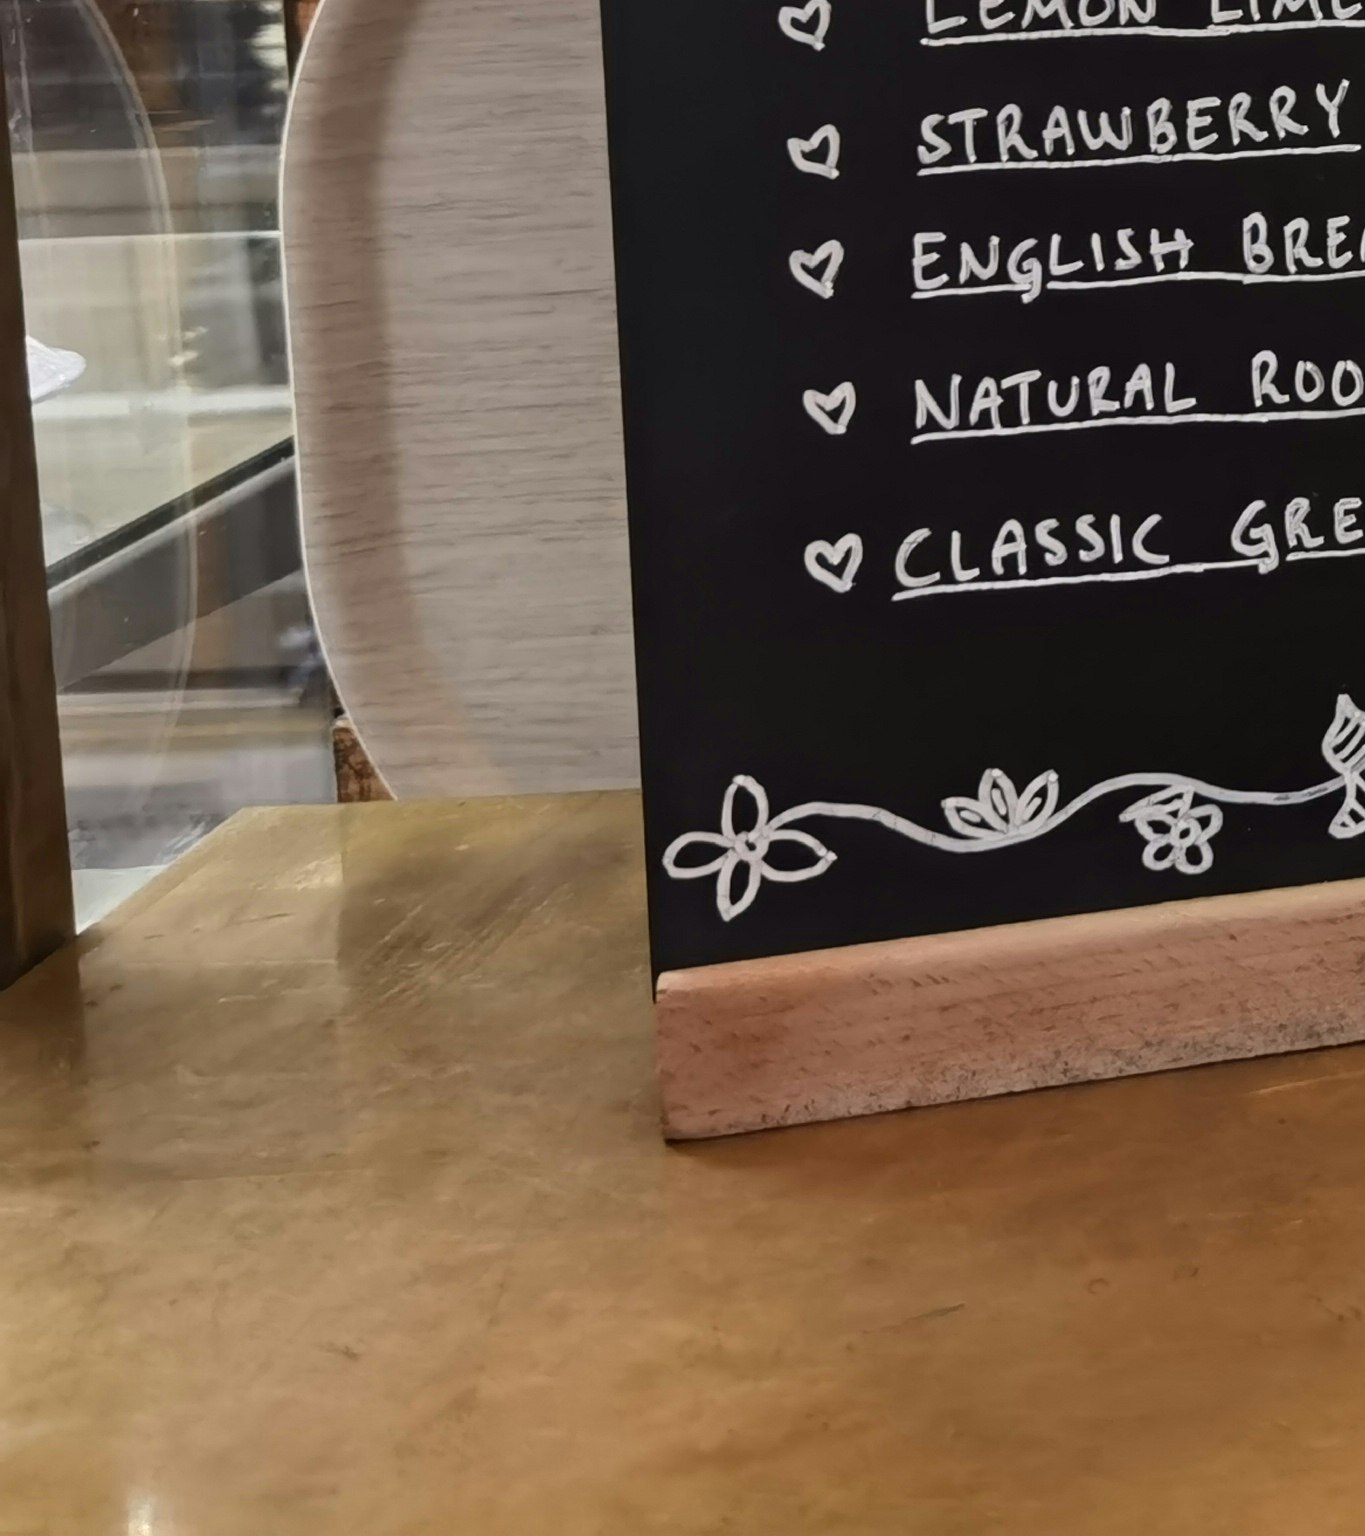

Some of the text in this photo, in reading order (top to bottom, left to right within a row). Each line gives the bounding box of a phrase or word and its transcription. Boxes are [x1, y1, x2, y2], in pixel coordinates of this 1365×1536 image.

[917, 78, 1351, 165] STRAWBERRY
[912, 226, 1192, 302] ENGLISH
[912, 361, 1197, 434] NATURAL
[895, 512, 1166, 588] CLASSIC
